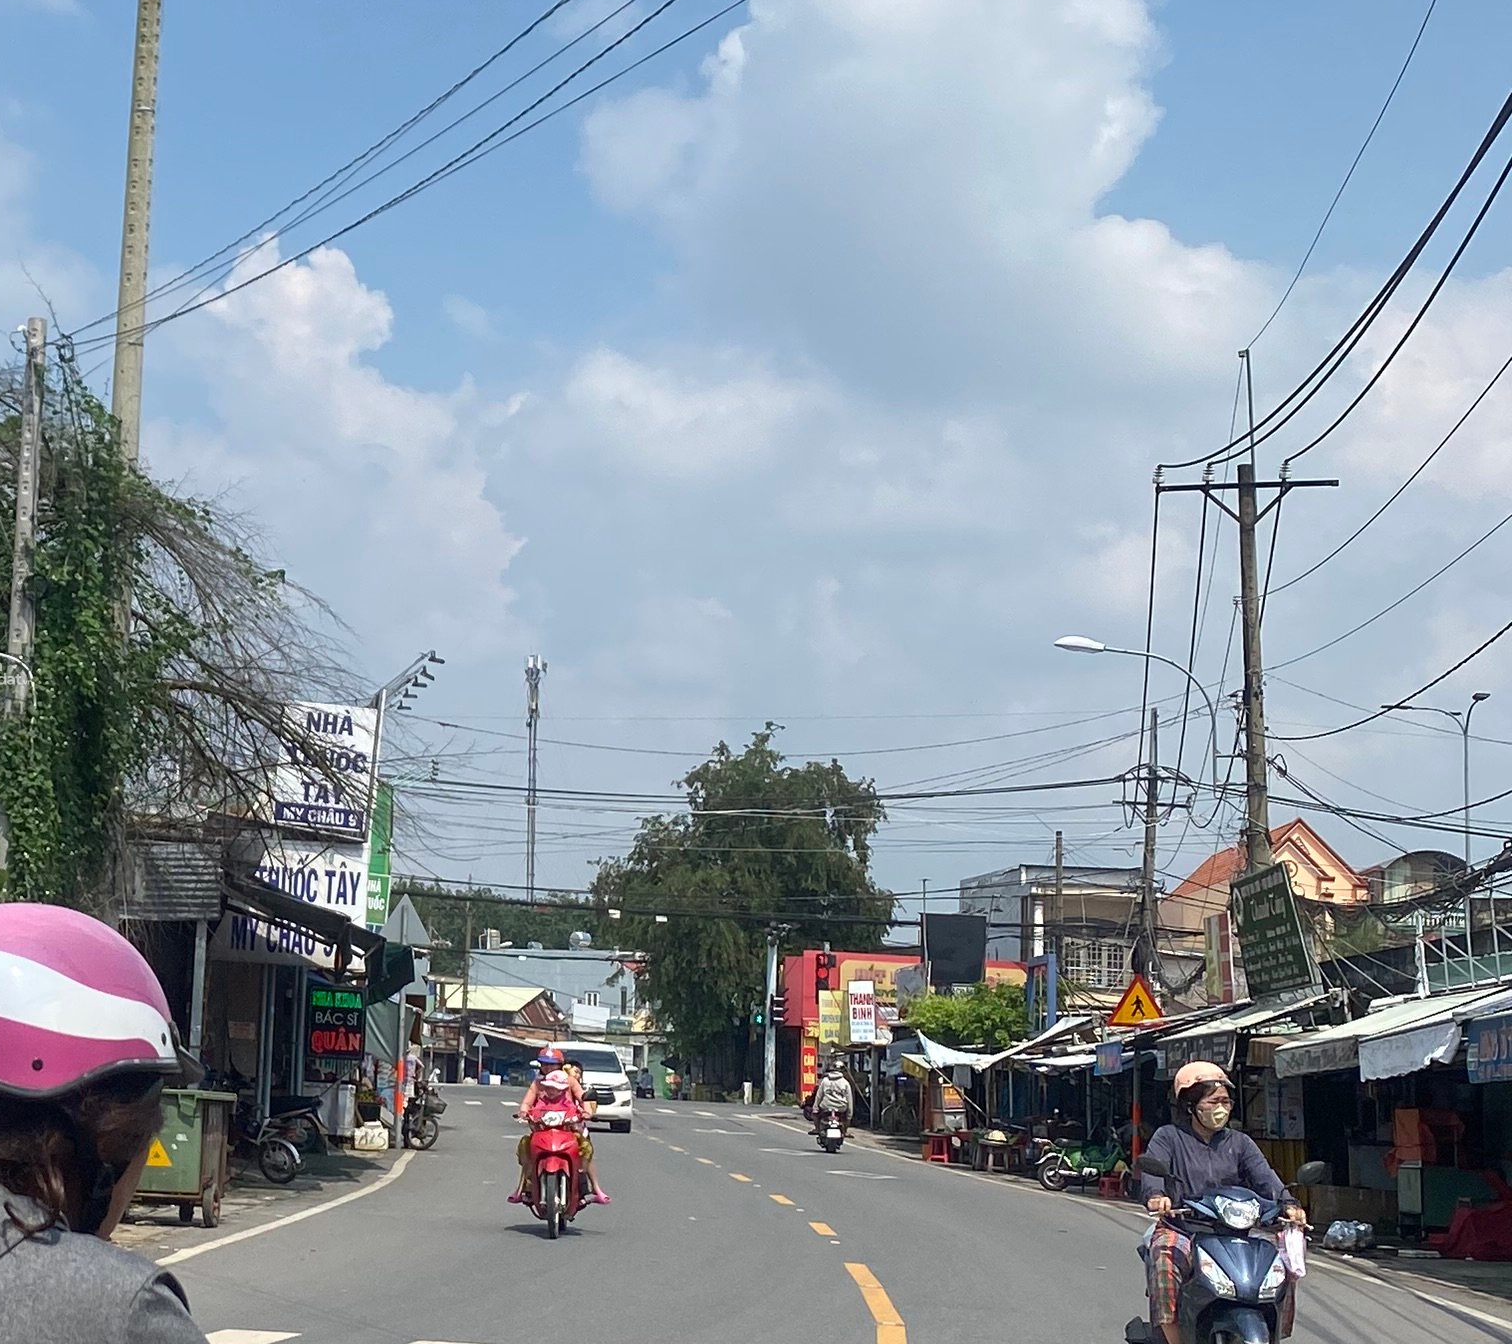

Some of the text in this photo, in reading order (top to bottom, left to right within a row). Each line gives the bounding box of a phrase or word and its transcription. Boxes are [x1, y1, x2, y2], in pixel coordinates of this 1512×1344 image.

[306, 709, 354, 736] NHÀ
[308, 807, 345, 826] CHÂU
[324, 861, 362, 906] TÂY
[368, 893, 386, 911] UỐC
[849, 992, 874, 1006] THANH
[315, 1009, 344, 1026] BÁC
[310, 1026, 362, 1054] QUÂN
